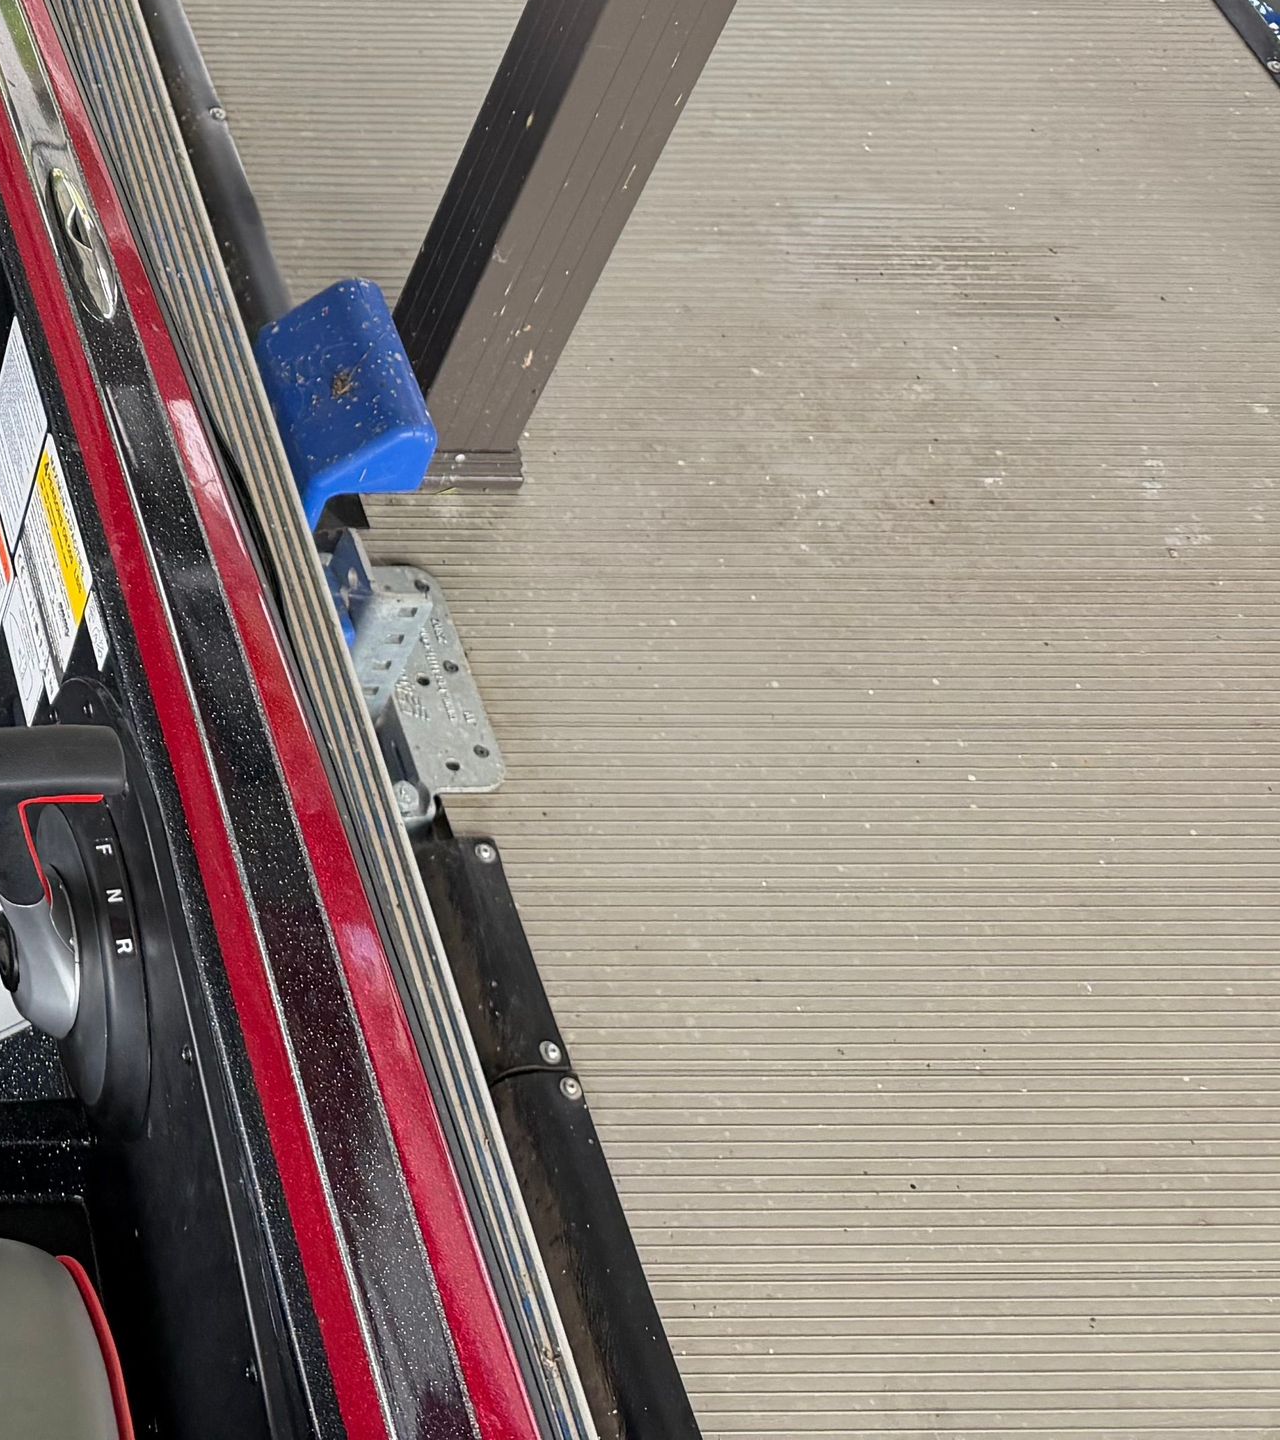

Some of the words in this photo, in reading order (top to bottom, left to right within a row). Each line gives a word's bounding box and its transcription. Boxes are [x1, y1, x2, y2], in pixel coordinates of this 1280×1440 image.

[96, 843, 113, 856] F
[106, 888, 123, 903] N
[115, 937, 134, 954] R
